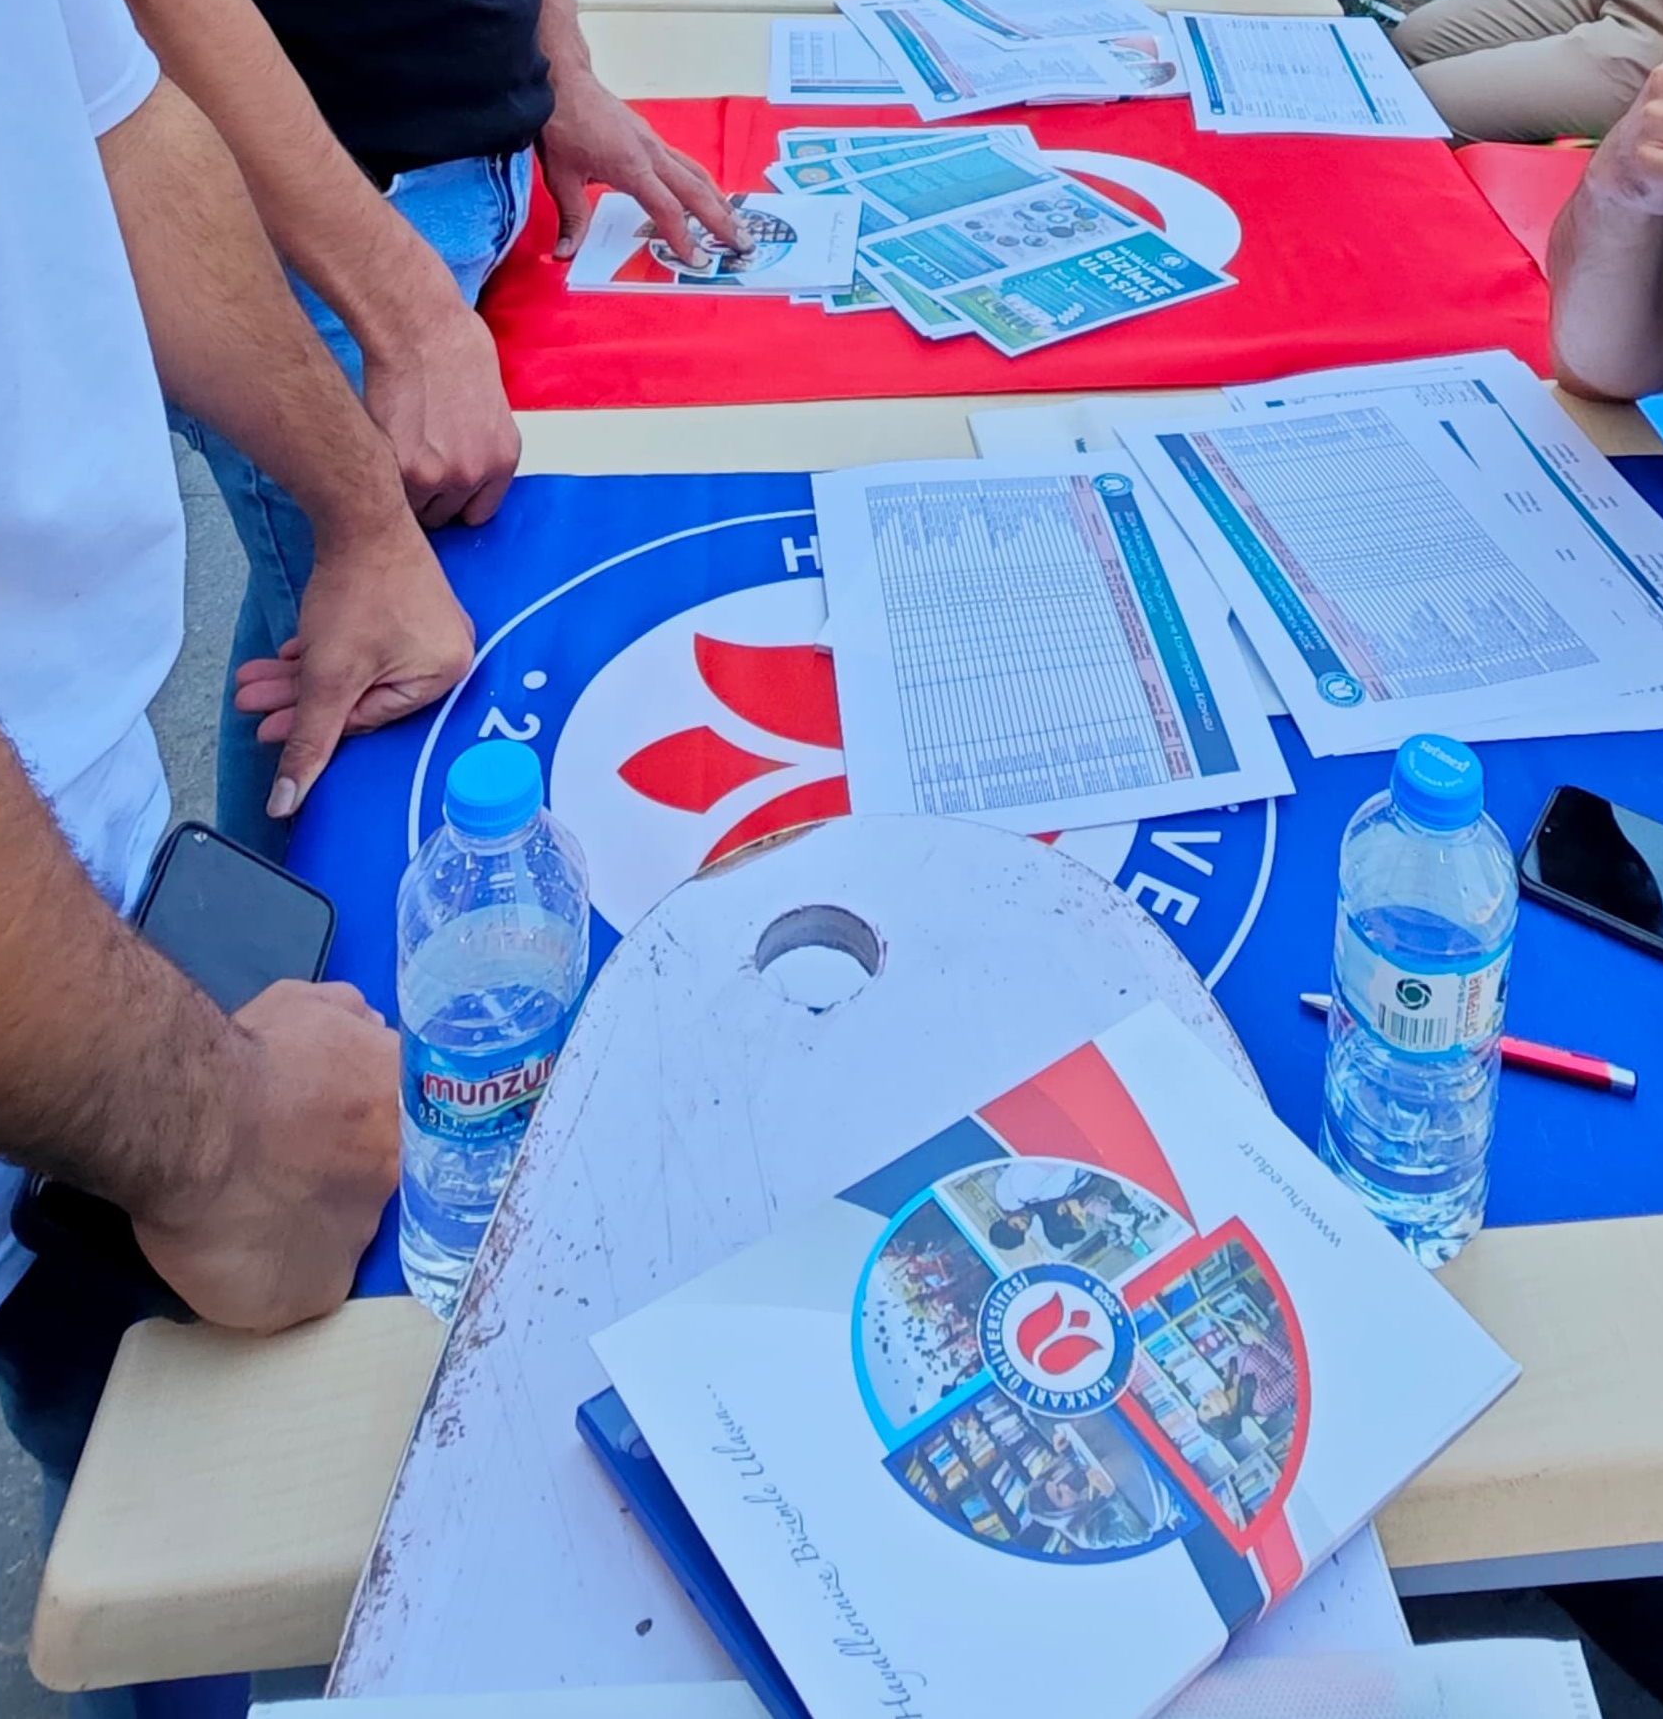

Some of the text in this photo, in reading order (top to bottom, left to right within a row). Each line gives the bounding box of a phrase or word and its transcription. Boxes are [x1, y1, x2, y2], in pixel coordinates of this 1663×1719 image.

[1078, 256, 1151, 304] ULAŞIN
[1095, 250, 1172, 298] BİZİMLE
[424, 1051, 557, 1106] munzur
[1238, 1142, 1341, 1248] www.hu.edu.tr
[986, 1271, 1115, 1409] HAKKARİ ÜNİVERSİTESİ
